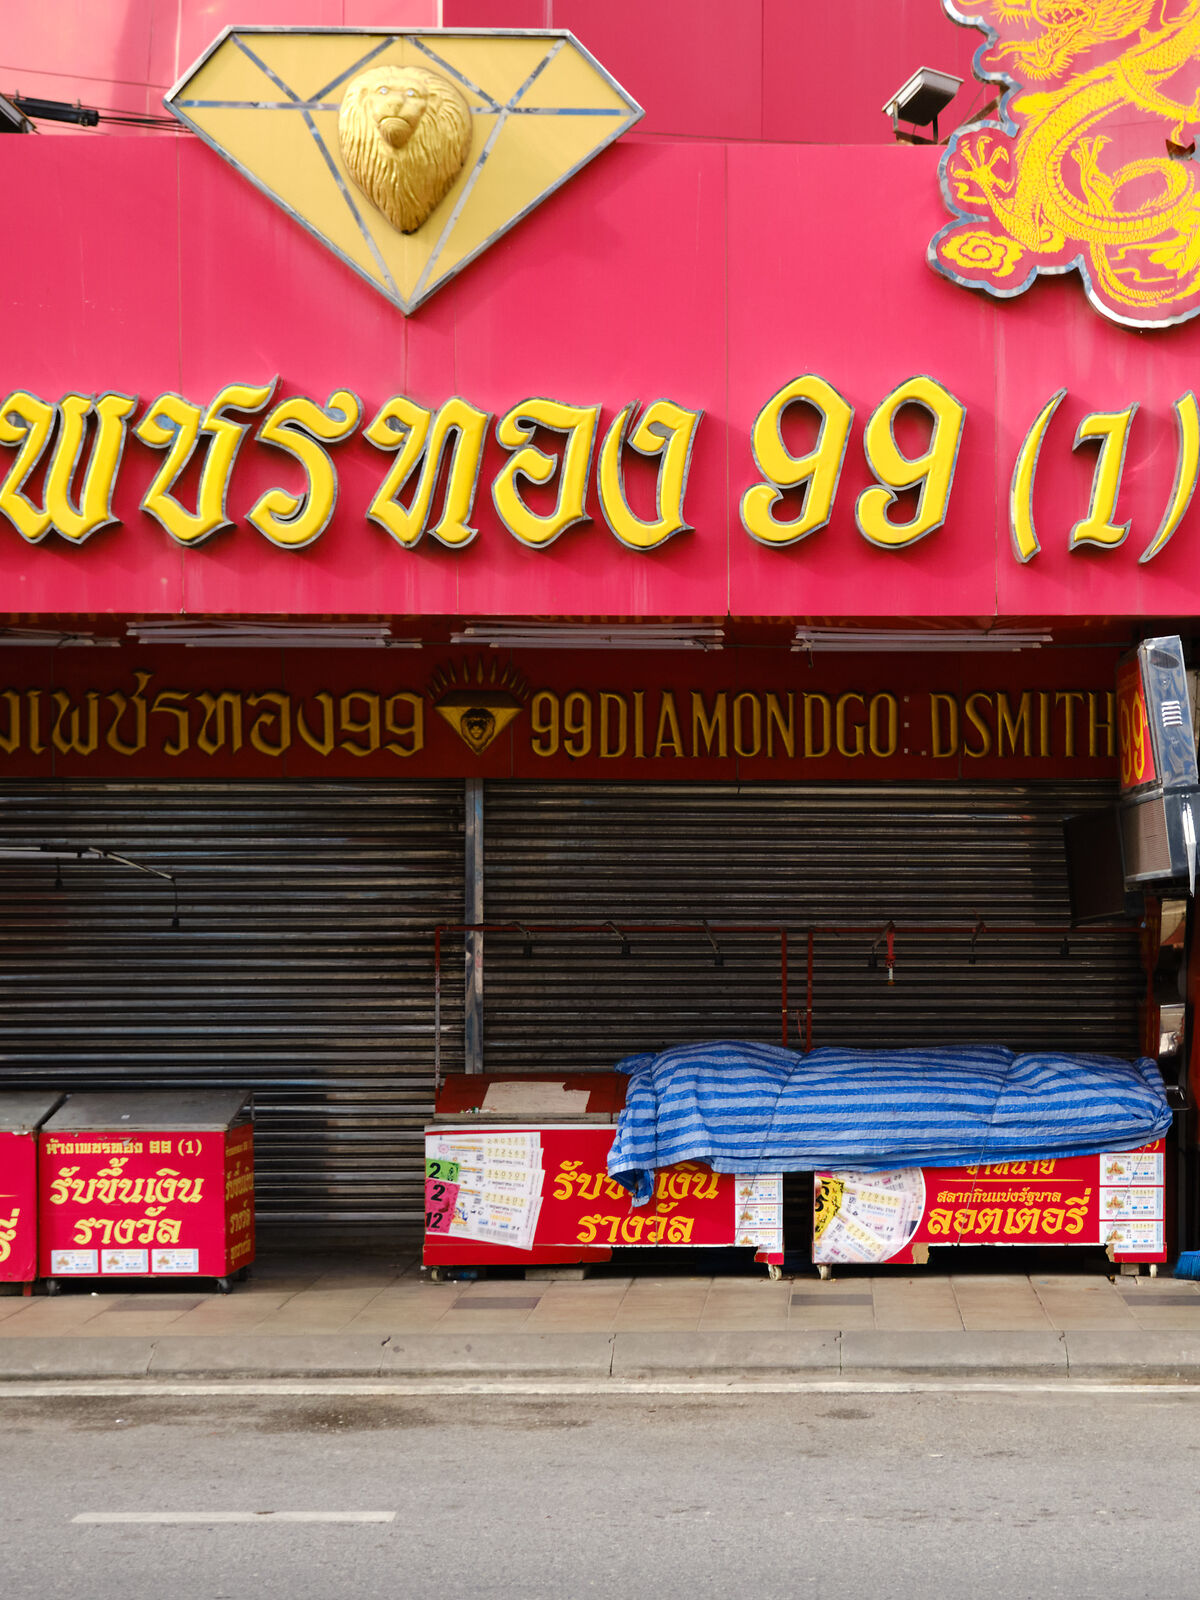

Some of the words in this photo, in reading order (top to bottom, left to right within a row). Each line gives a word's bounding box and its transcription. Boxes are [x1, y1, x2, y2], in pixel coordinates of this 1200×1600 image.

[739, 373, 967, 549] 99
[178, 1138, 202, 1157] (1)
[49, 1157, 205, 1205] รับขึ้นเงิน
[73, 1205, 182, 1245] รางวัล
[576, 1201, 695, 1243] รางวัล
[927, 1188, 1092, 1235] ลอตเตอรี่
